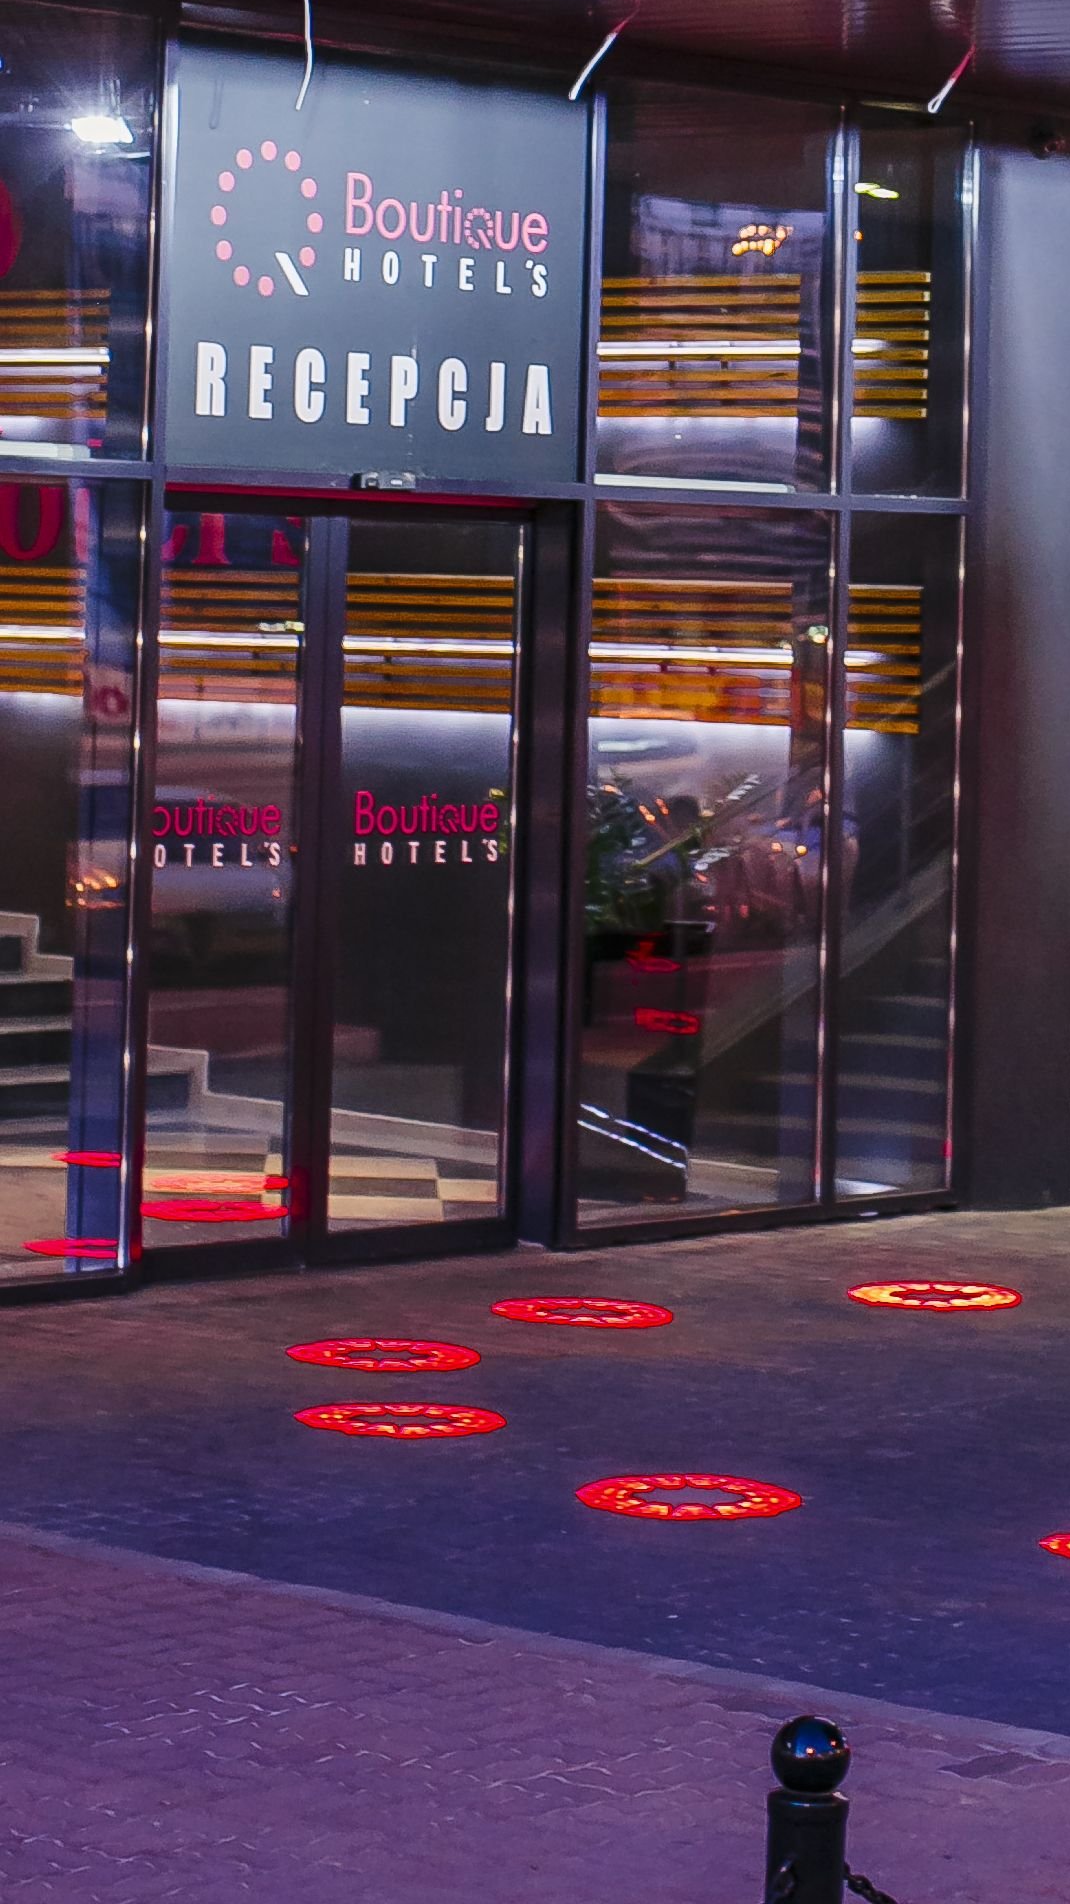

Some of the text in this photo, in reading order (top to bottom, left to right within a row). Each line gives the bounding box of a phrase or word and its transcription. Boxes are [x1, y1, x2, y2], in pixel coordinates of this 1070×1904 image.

[344, 247, 548, 298] HOTEL'S
[195, 340, 553, 436] RECEPCJA
[153, 842, 282, 868] OTEL'S
[353, 839, 498, 865] HOTEL'S
